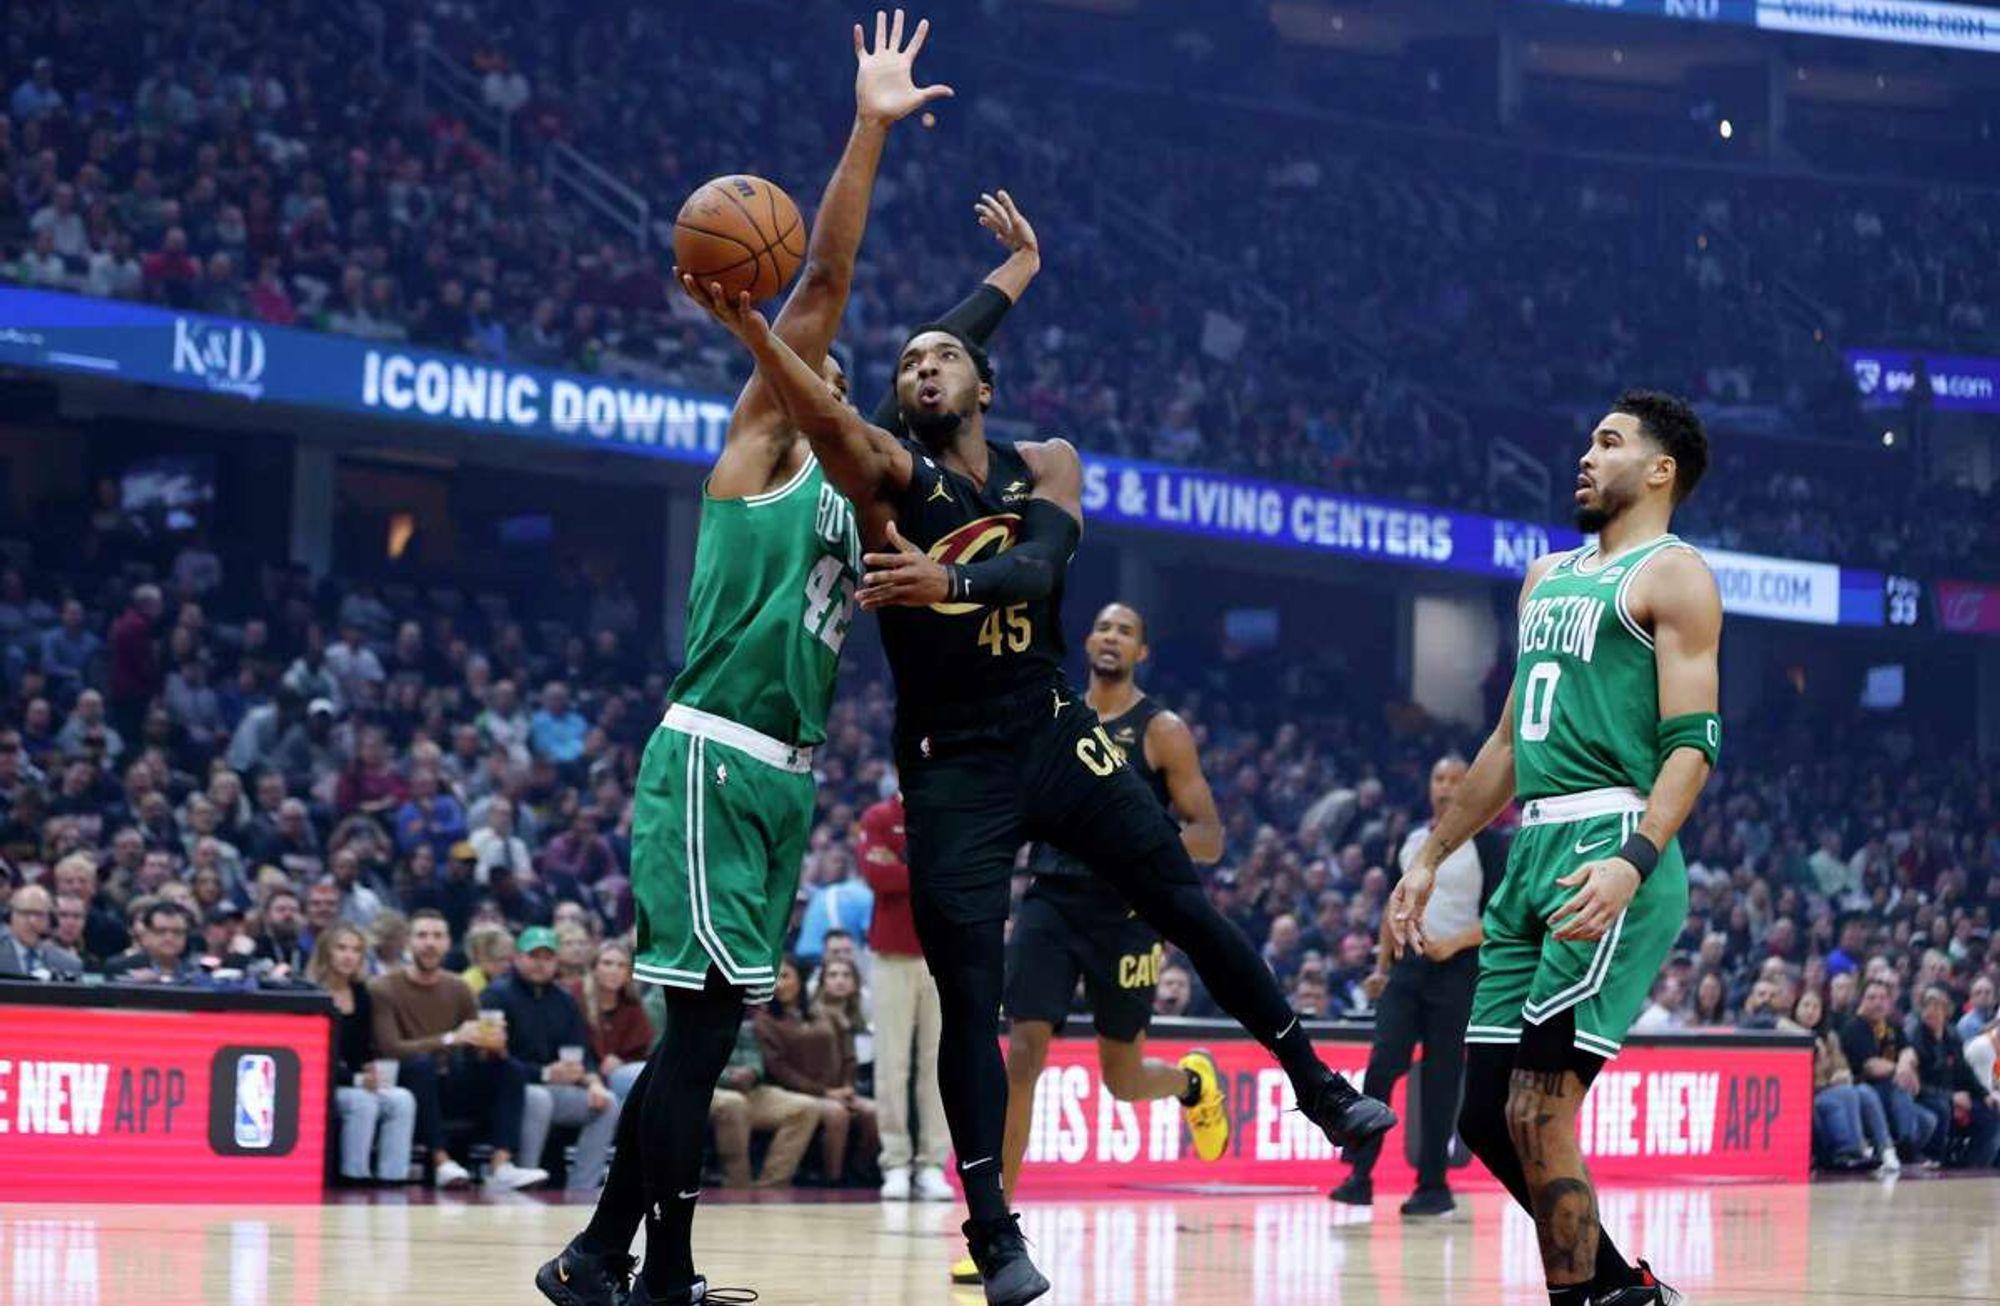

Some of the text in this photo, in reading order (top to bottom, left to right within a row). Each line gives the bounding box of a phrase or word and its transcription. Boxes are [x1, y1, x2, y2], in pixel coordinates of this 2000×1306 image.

[173, 317, 265, 382] K&D
[363, 350, 731, 453] ICONIC DOWNT
[1118, 468, 1146, 515] &
[1156, 474, 1284, 535] LIVING
[1291, 497, 1453, 561] CENTERS
[803, 554, 854, 653] 42
[978, 602, 1032, 656] 45
[1520, 661, 1561, 741] 0
[17, 1060, 110, 1135] NEW
[114, 1067, 186, 1133] APP
[1579, 1071, 1780, 1156] THE NEW APP
